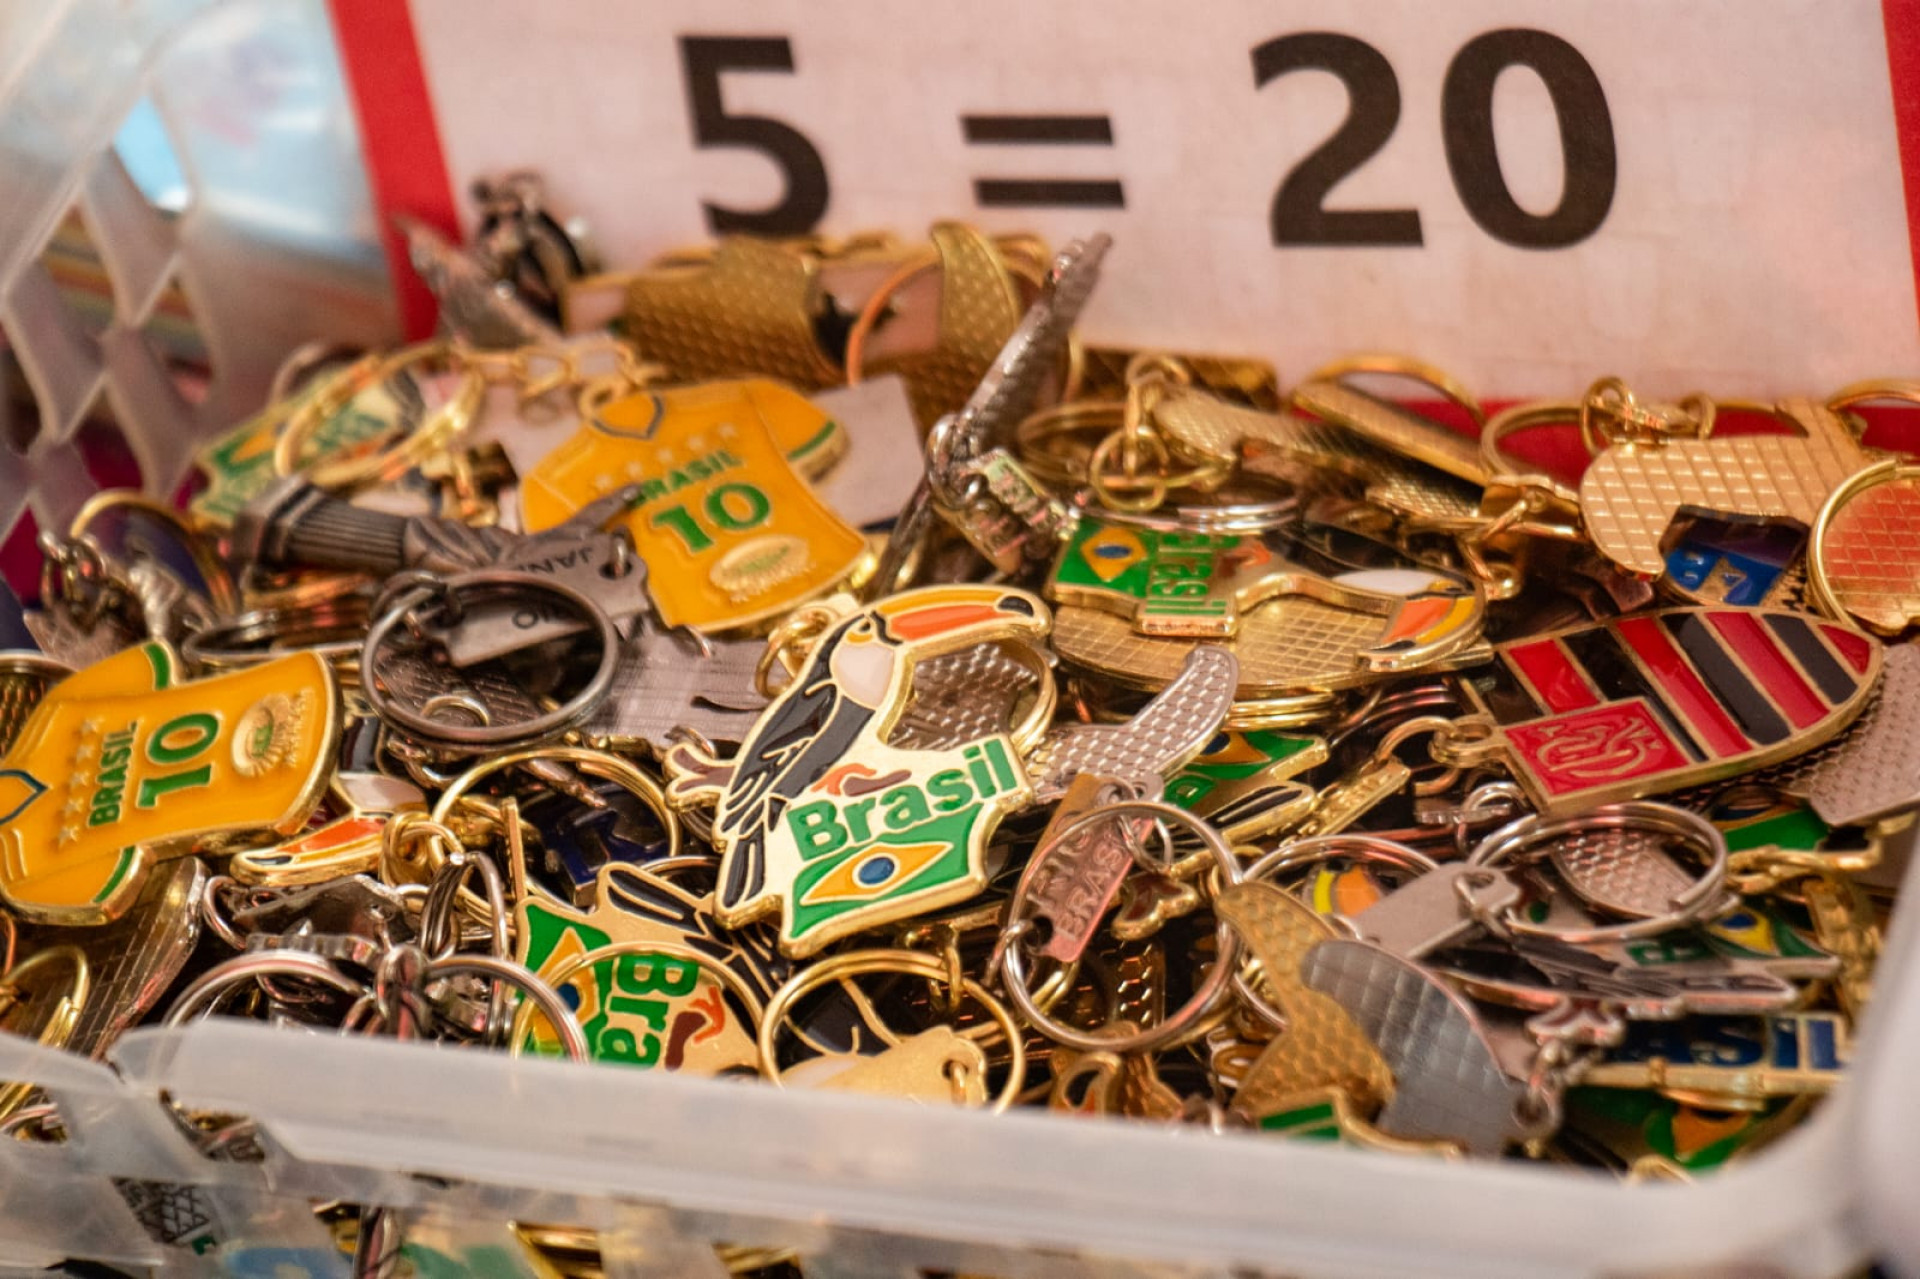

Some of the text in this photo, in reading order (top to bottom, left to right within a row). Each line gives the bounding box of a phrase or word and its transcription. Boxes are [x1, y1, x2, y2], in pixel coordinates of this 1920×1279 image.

[677, 35, 831, 238] 5
[1249, 27, 1619, 252] 20
[627, 448, 745, 510] RASIL
[652, 481, 771, 553] 10
[517, 547, 594, 574] JAN
[88, 720, 139, 828] BRASIL
[136, 712, 221, 809] 10
[786, 737, 1019, 862] Brasil
